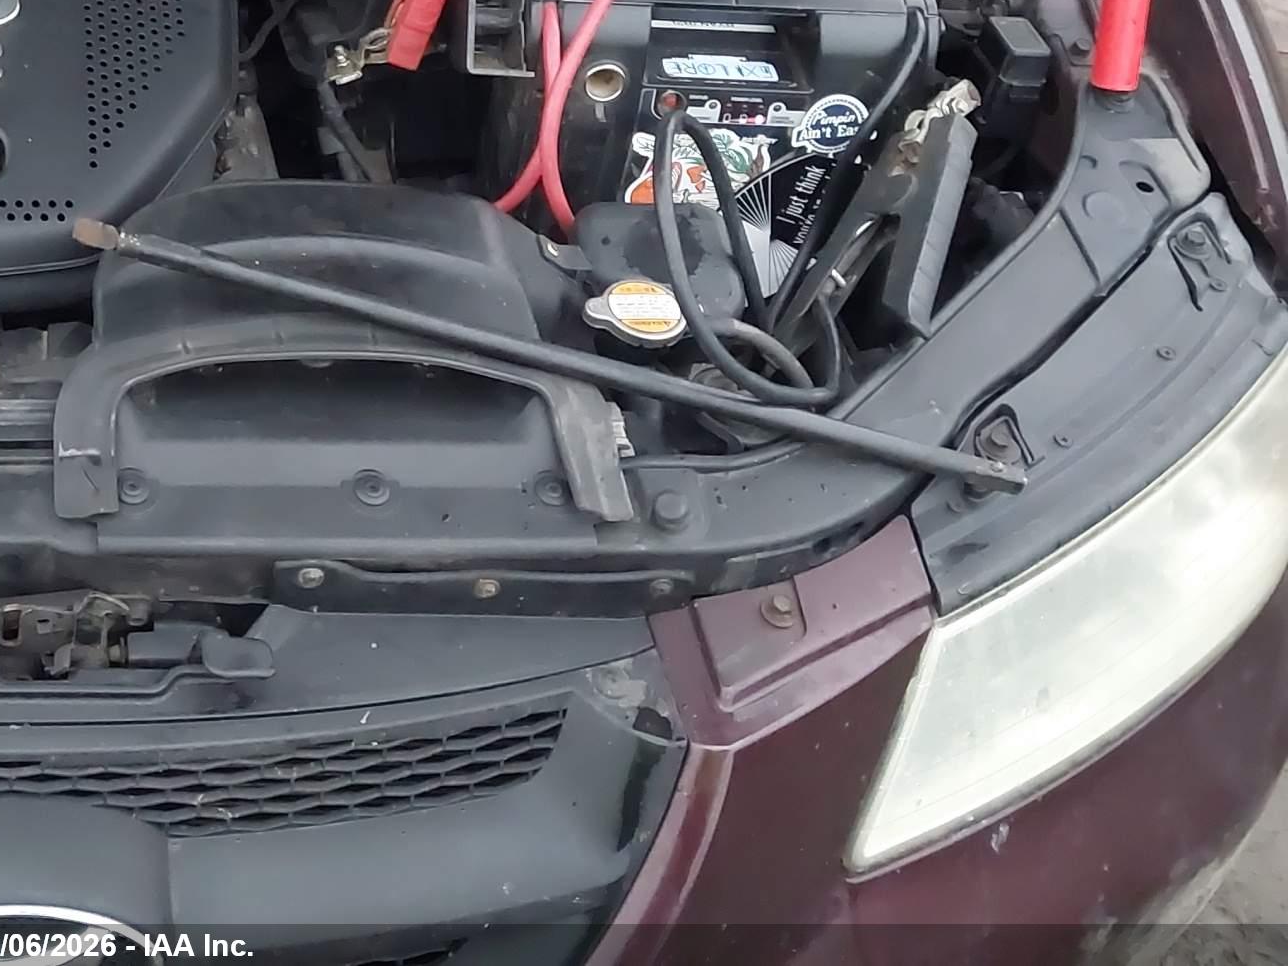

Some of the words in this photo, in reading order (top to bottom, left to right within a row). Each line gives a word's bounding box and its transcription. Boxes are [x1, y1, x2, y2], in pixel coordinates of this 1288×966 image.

[812, 109, 857, 126] Pimpin
[798, 126, 832, 141] Ain't
[794, 165, 828, 195] think
[780, 195, 809, 220] just
[776, 215, 796, 224] I
